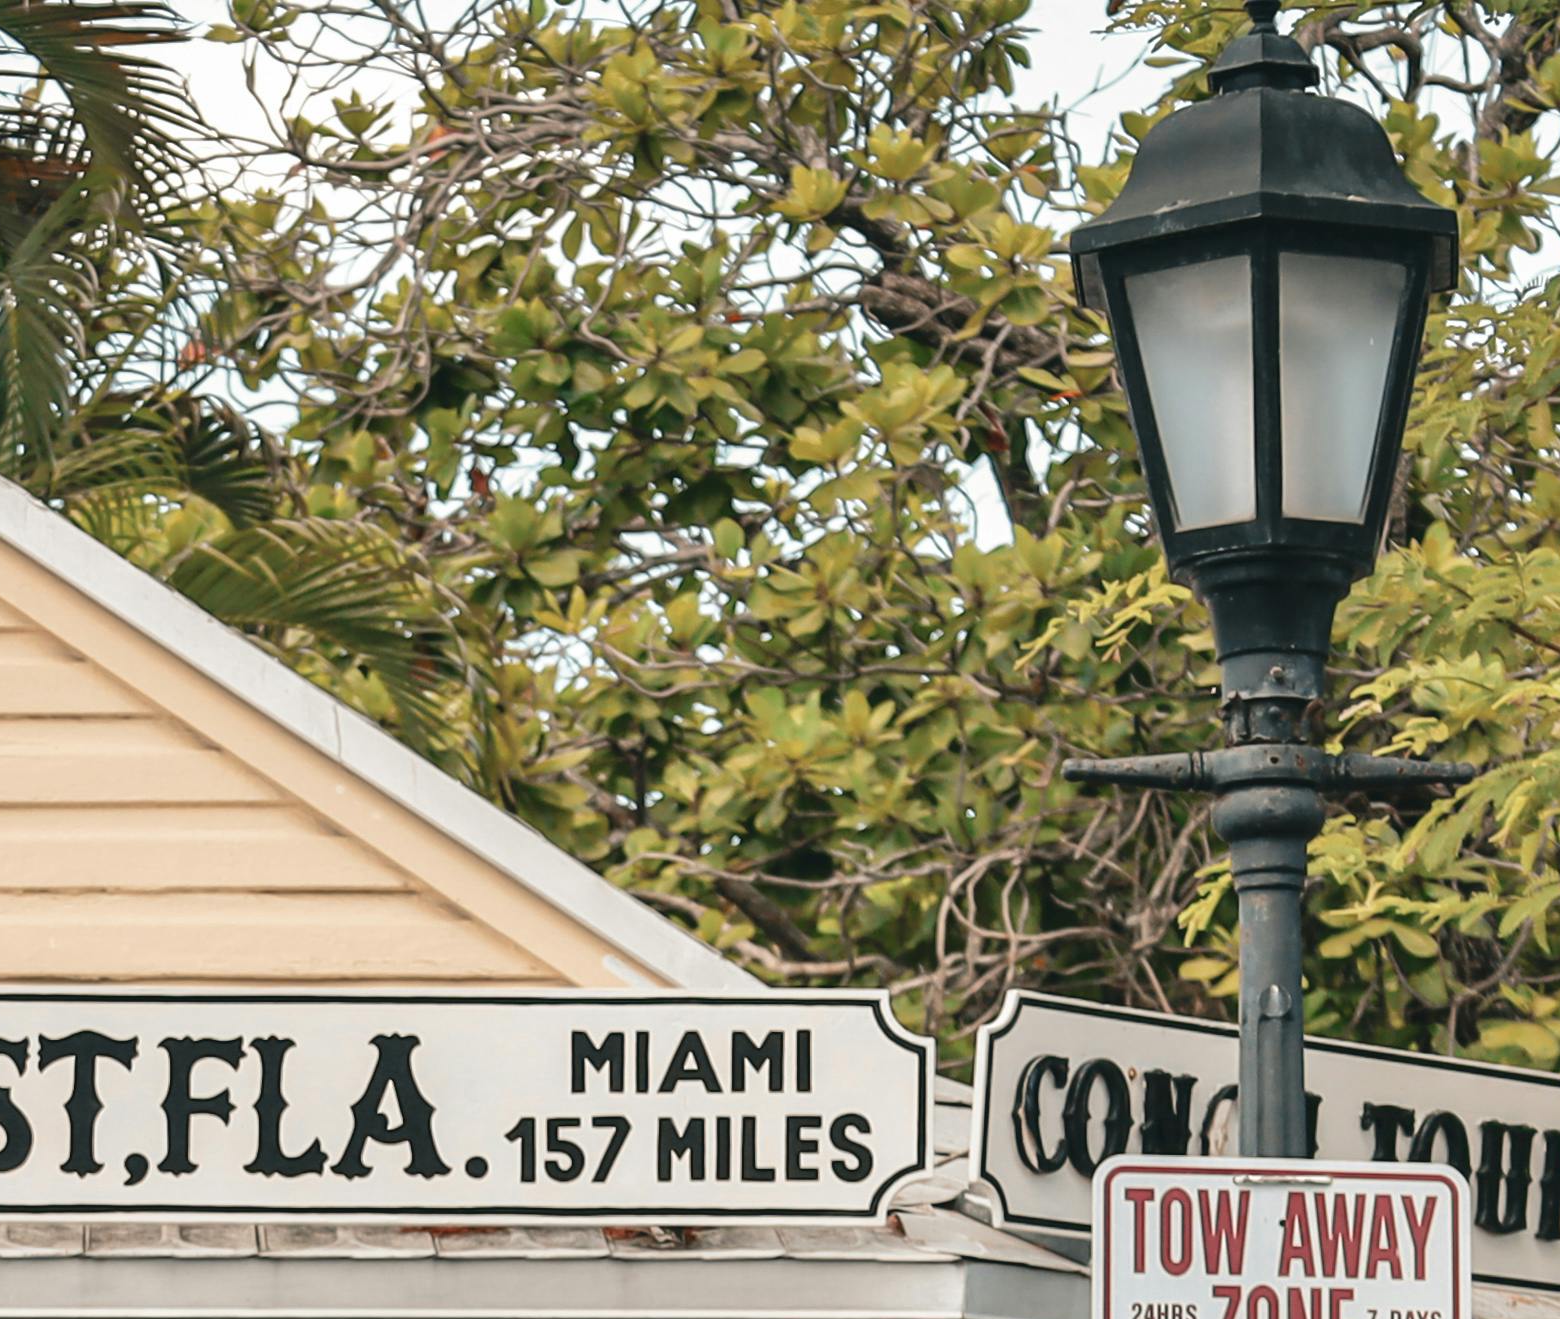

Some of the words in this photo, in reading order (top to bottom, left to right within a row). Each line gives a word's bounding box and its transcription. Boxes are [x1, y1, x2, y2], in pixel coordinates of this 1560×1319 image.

[571, 1030, 812, 1095] MIAMI
[505, 1115, 630, 1184] 157
[656, 1113, 874, 1183] MILES
[1011, 1054, 1322, 1176] CON
[1124, 1187, 1251, 1276] TOW
[1278, 1191, 1438, 1281] AWAY
